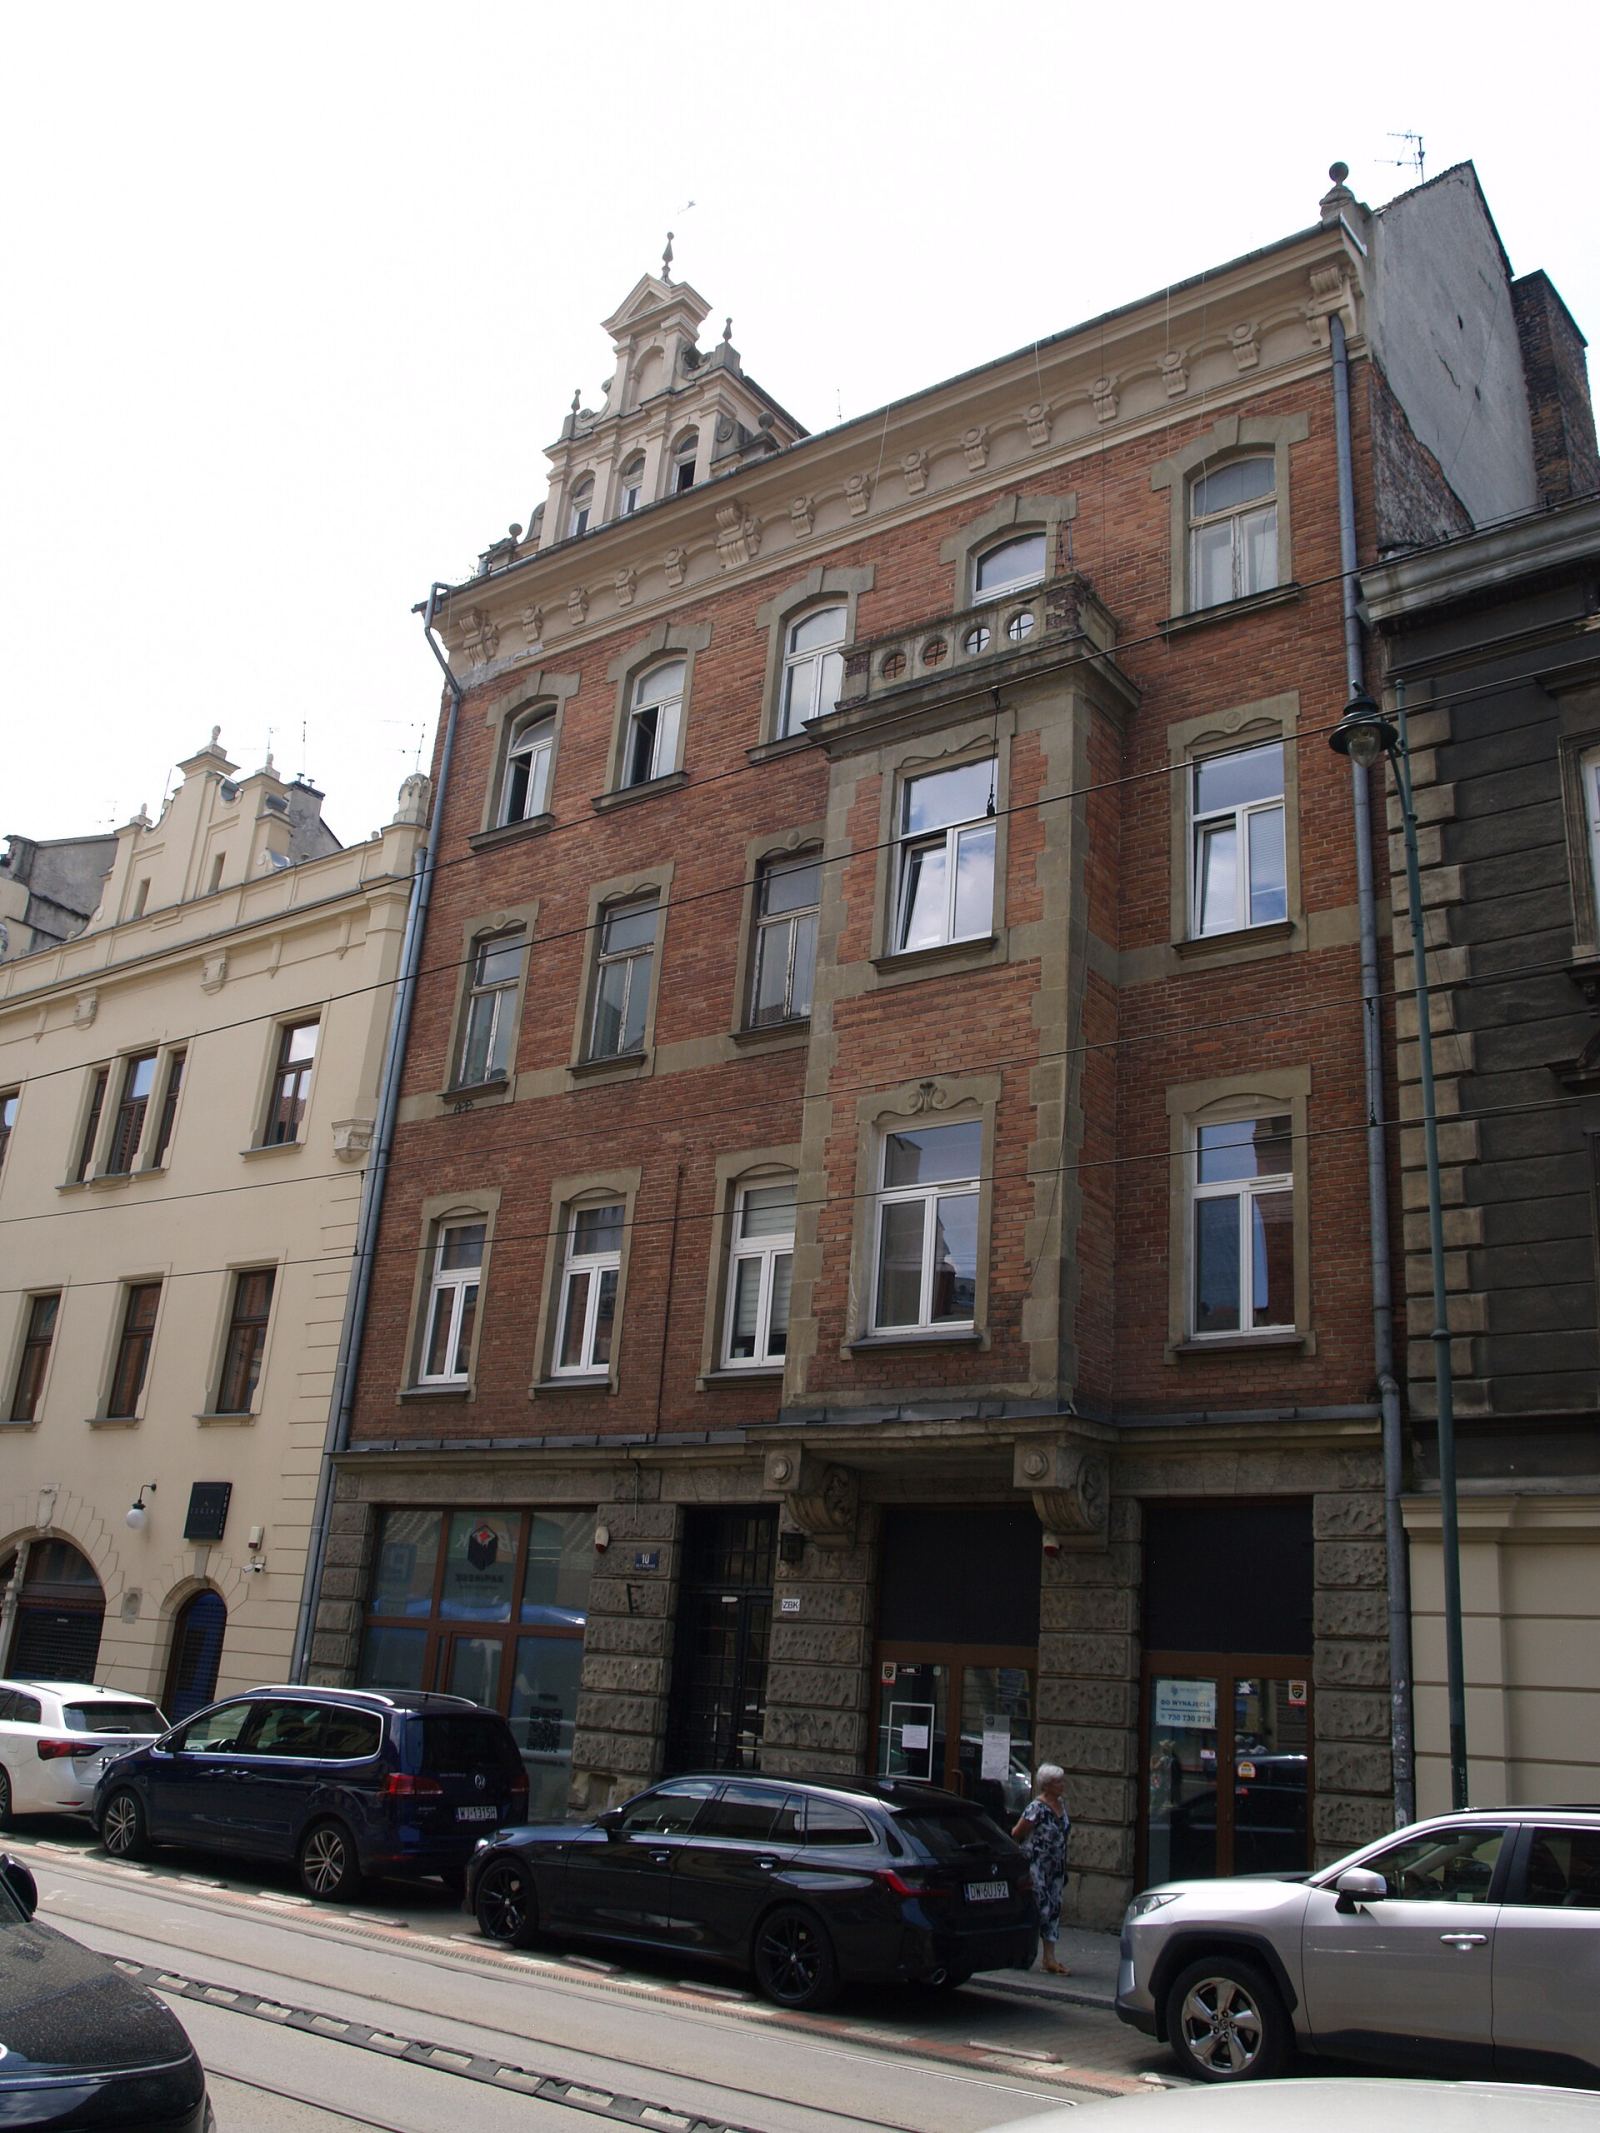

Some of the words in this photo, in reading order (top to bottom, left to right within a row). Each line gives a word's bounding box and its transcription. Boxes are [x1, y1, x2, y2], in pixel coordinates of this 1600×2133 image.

[641, 1553, 650, 1564] 10
[783, 1600, 799, 1609] ZBK
[984, 1882, 1007, 1898] 6UJ92
